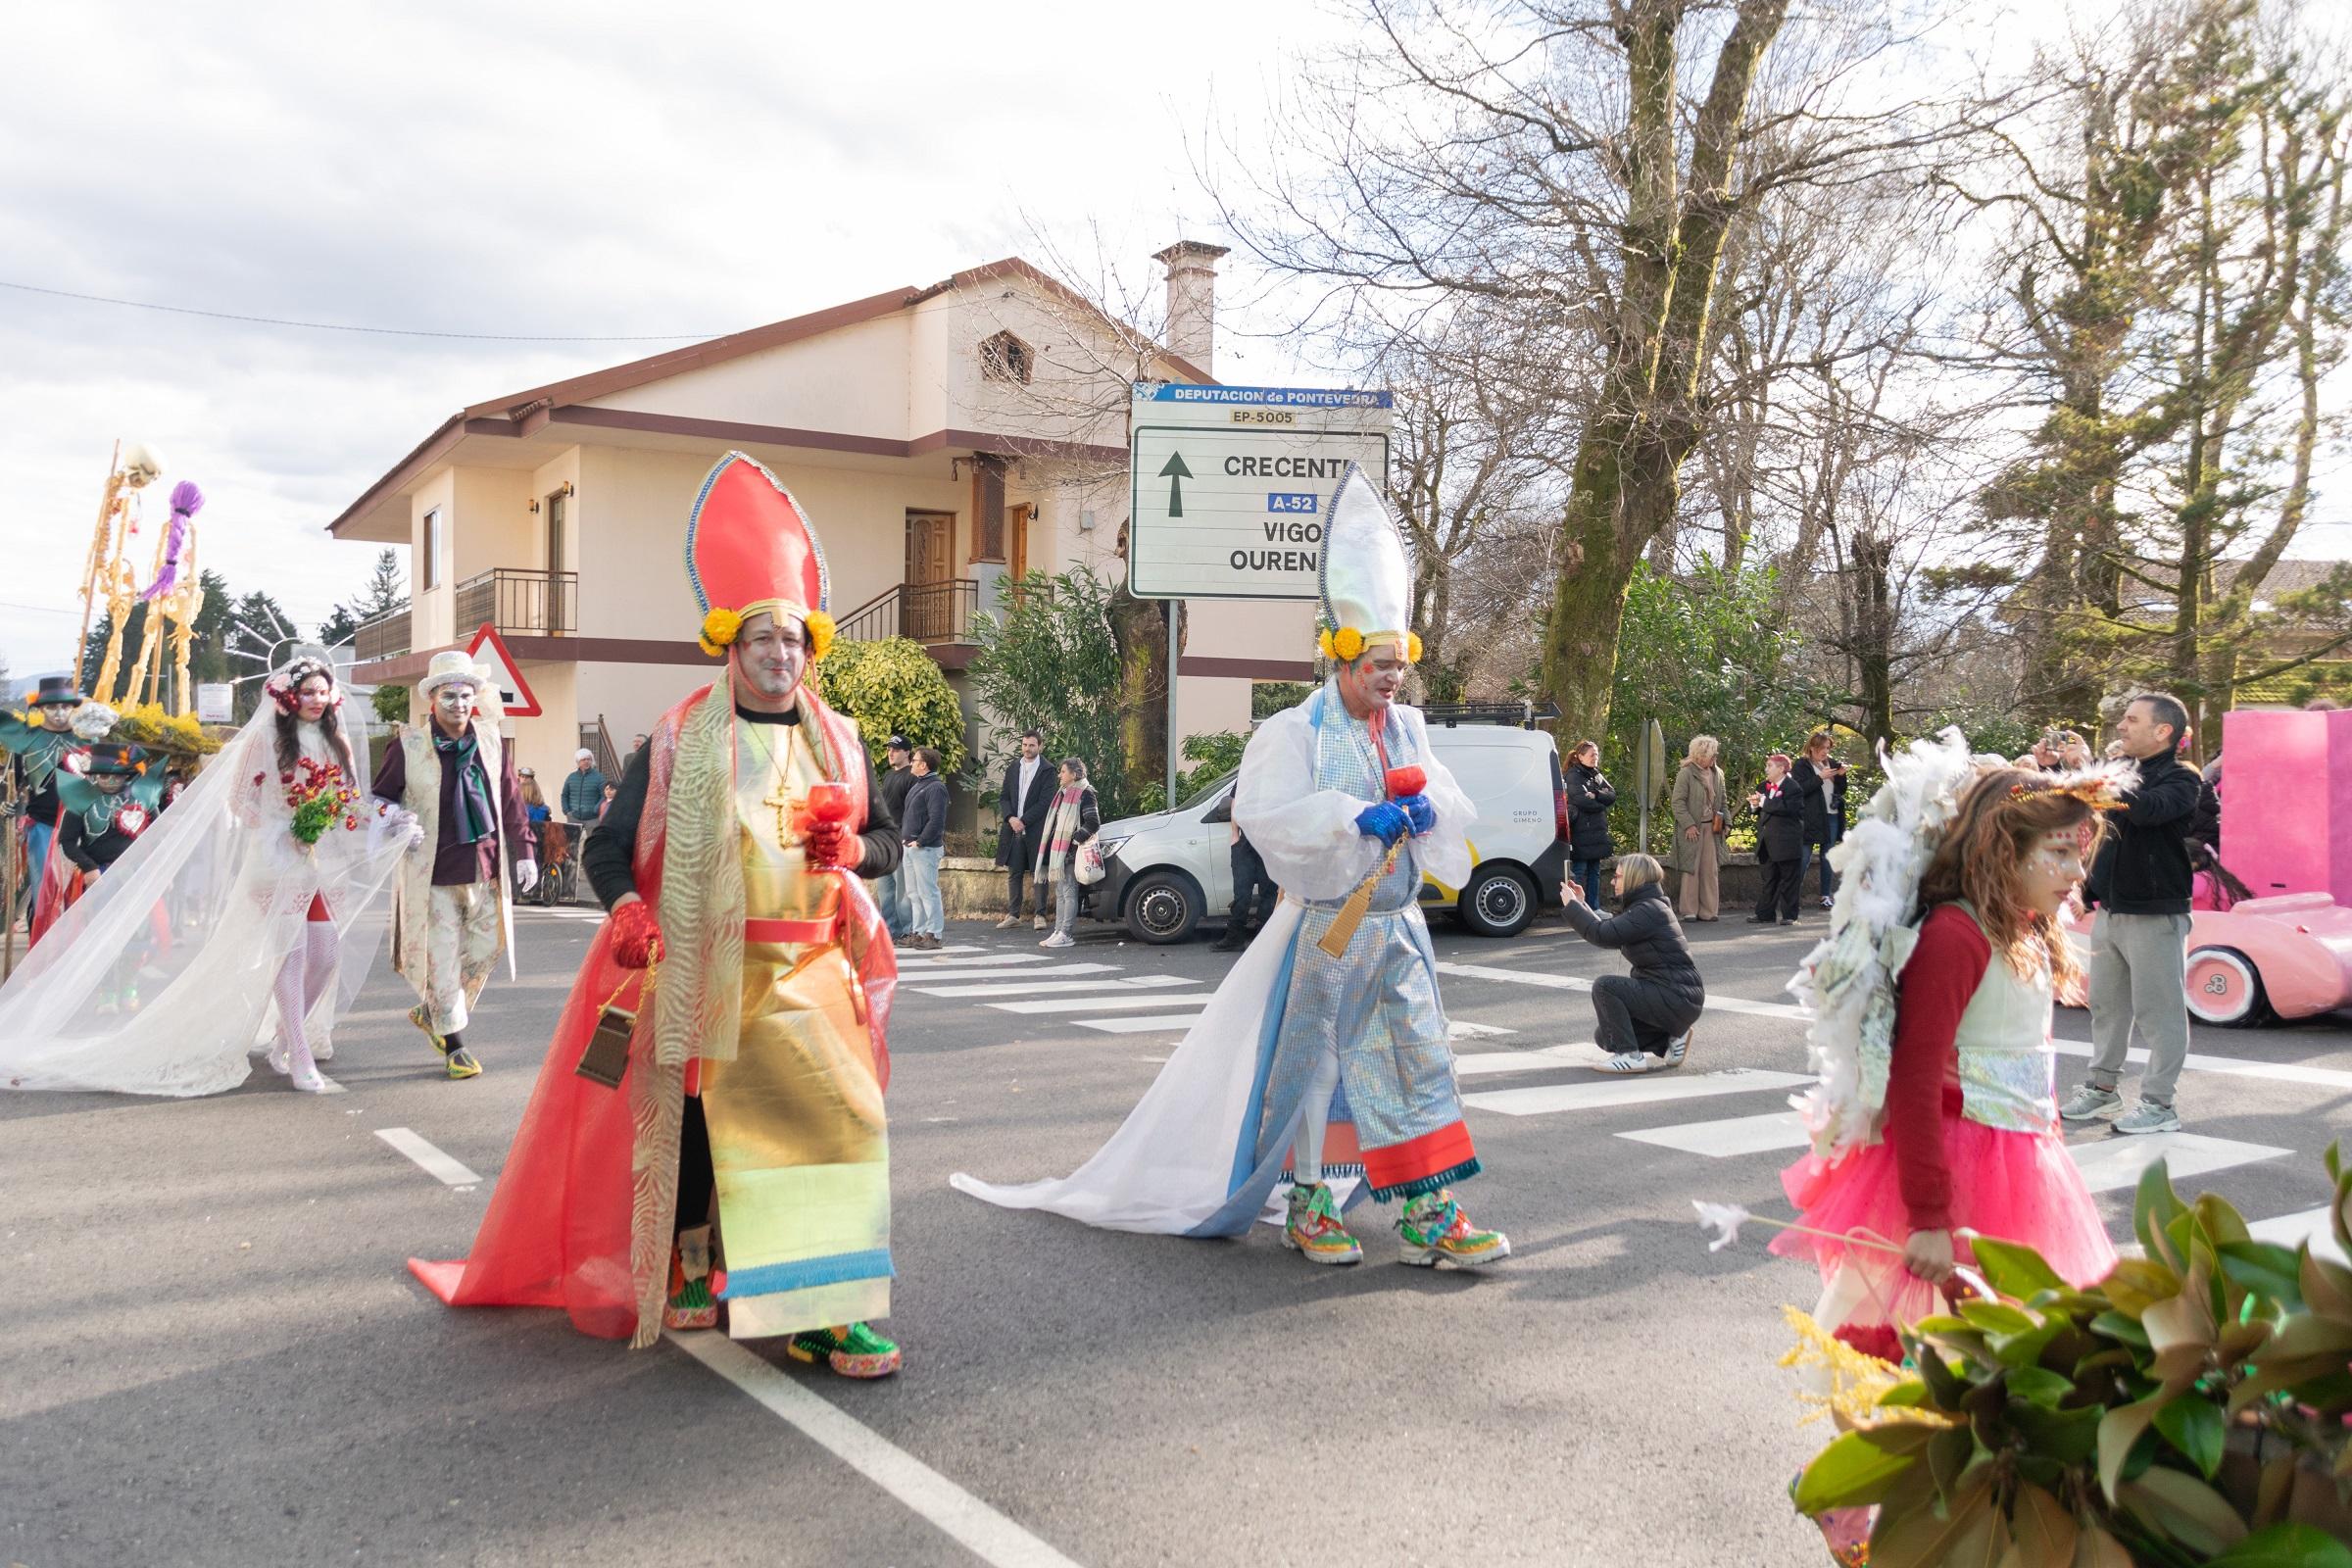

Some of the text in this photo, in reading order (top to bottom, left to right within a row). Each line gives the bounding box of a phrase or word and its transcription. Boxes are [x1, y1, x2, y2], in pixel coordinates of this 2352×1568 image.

[1175, 388, 1379, 405] DEPUTACION de PONTEVEDRA
[1273, 496, 1312, 511] A-52
[1263, 521, 1322, 543] VIGO
[1230, 550, 1317, 571] OUREN
